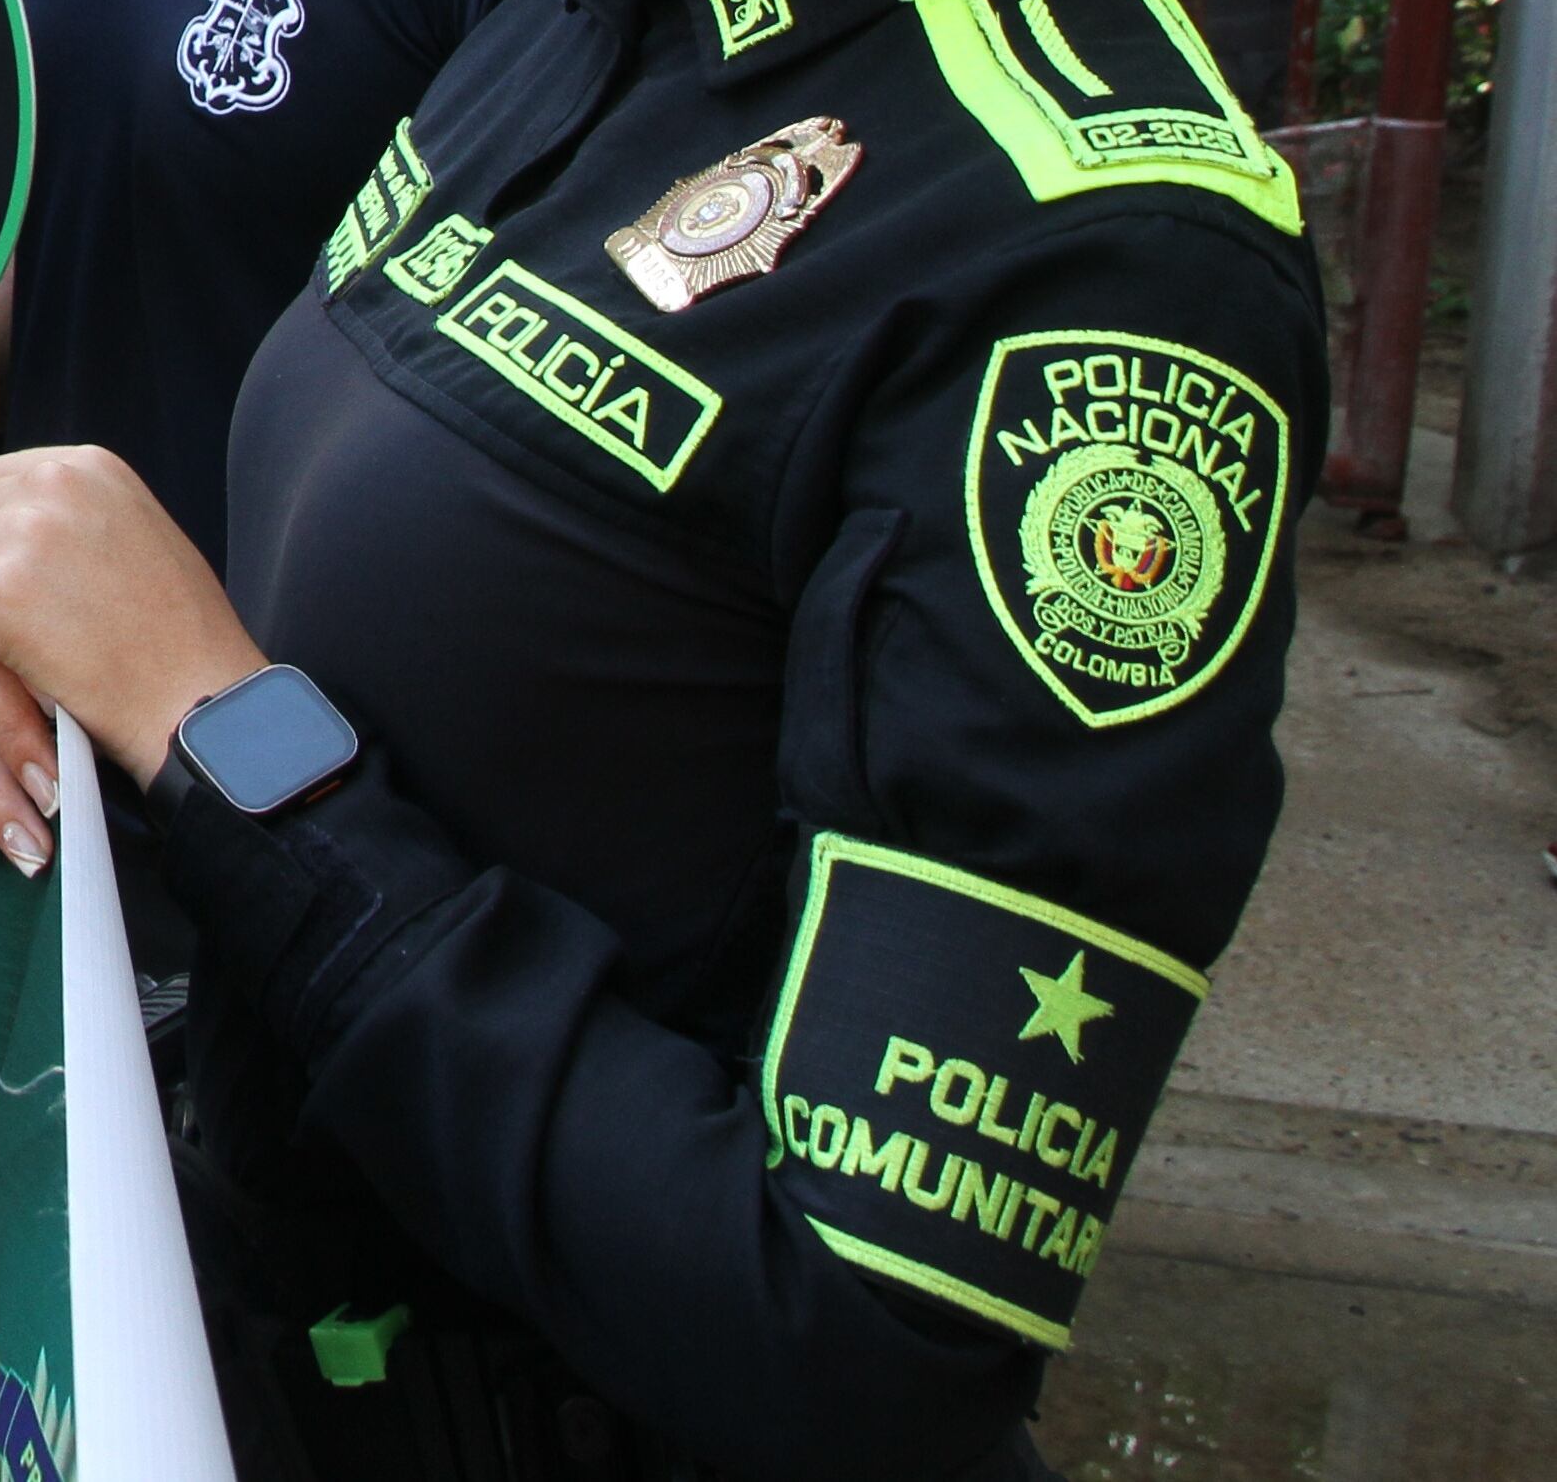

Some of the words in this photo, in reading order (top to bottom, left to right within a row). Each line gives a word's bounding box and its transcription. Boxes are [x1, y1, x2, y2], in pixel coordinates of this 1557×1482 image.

[1090, 121, 1242, 156] 02-2025
[464, 291, 649, 450] POLICÍA
[1044, 354, 1255, 457] POLICÍA
[996, 401, 1262, 532] NACIONAL
[1035, 630, 1176, 688] COLOMBIA
[1099, 620, 1114, 640] Y
[1114, 621, 1178, 646] PATRIA
[874, 1035, 1118, 1189] POLICIA
[784, 1095, 1104, 1277] COMUNITAR
